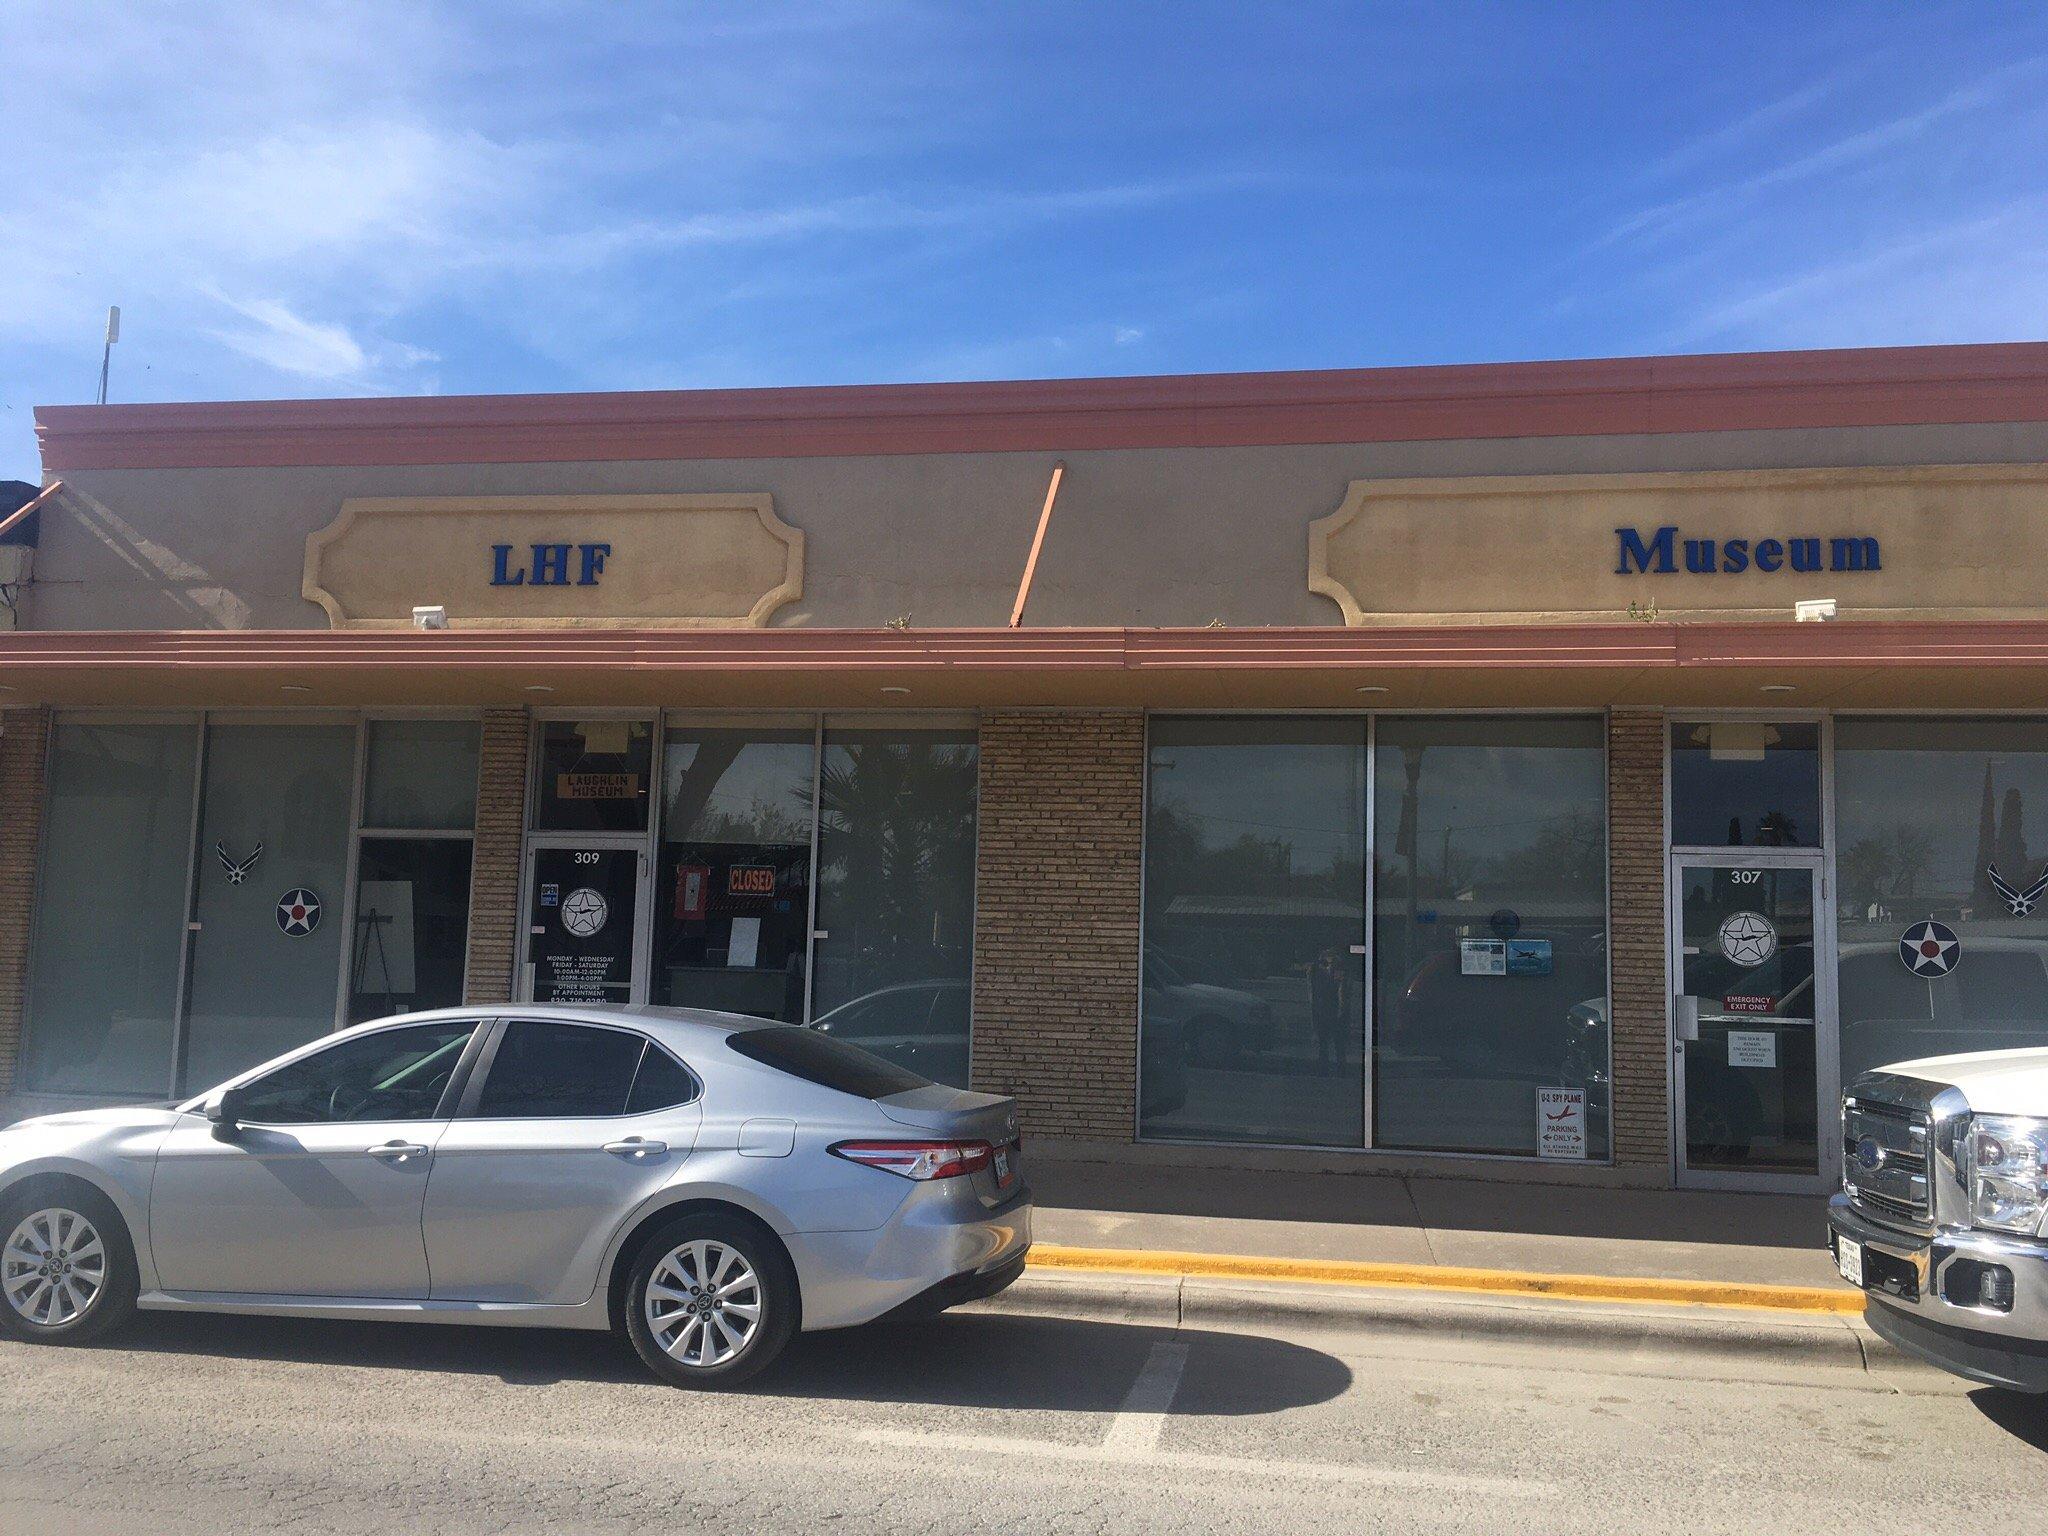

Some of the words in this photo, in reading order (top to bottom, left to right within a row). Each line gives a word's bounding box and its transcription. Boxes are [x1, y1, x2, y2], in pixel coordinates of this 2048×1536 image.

[1614, 526, 1882, 575] Museum
[490, 543, 611, 587] LHF
[568, 775, 628, 786] LAUGHLIN
[572, 786, 622, 796] MUSEUM
[574, 852, 600, 865] 309
[731, 869, 774, 891] CLOSED
[1731, 871, 1762, 884] 307
[1542, 1094, 1550, 1102] U-2
[1552, 1094, 1563, 1102] SPY
[1564, 1094, 1582, 1103] PLANE
[1547, 1125, 1578, 1133] PARKING
